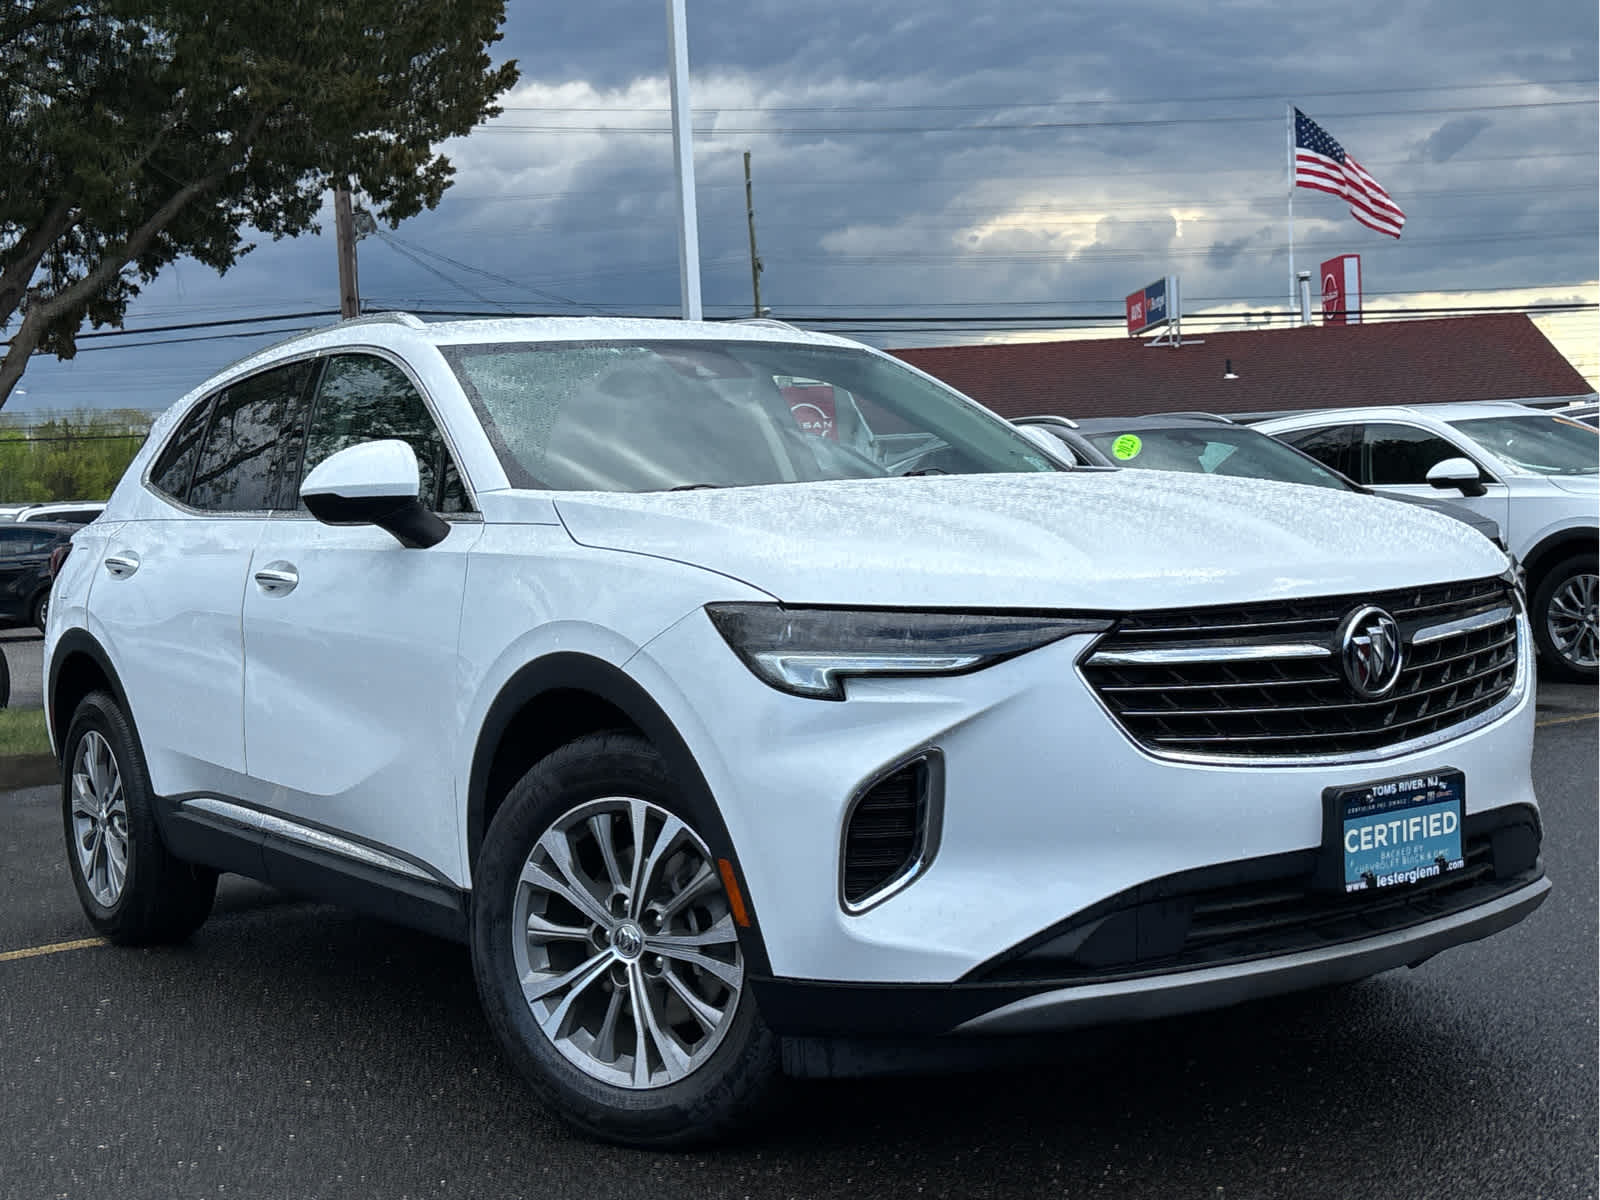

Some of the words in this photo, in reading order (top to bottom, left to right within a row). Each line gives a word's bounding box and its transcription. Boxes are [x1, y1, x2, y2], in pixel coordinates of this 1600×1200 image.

[802, 421, 832, 429] SAN
[1372, 783, 1397, 797] TOMS
[1427, 776, 1439, 787] NJ
[1344, 811, 1458, 853] CERTIFIED
[1376, 865, 1440, 888] lesterglenn
